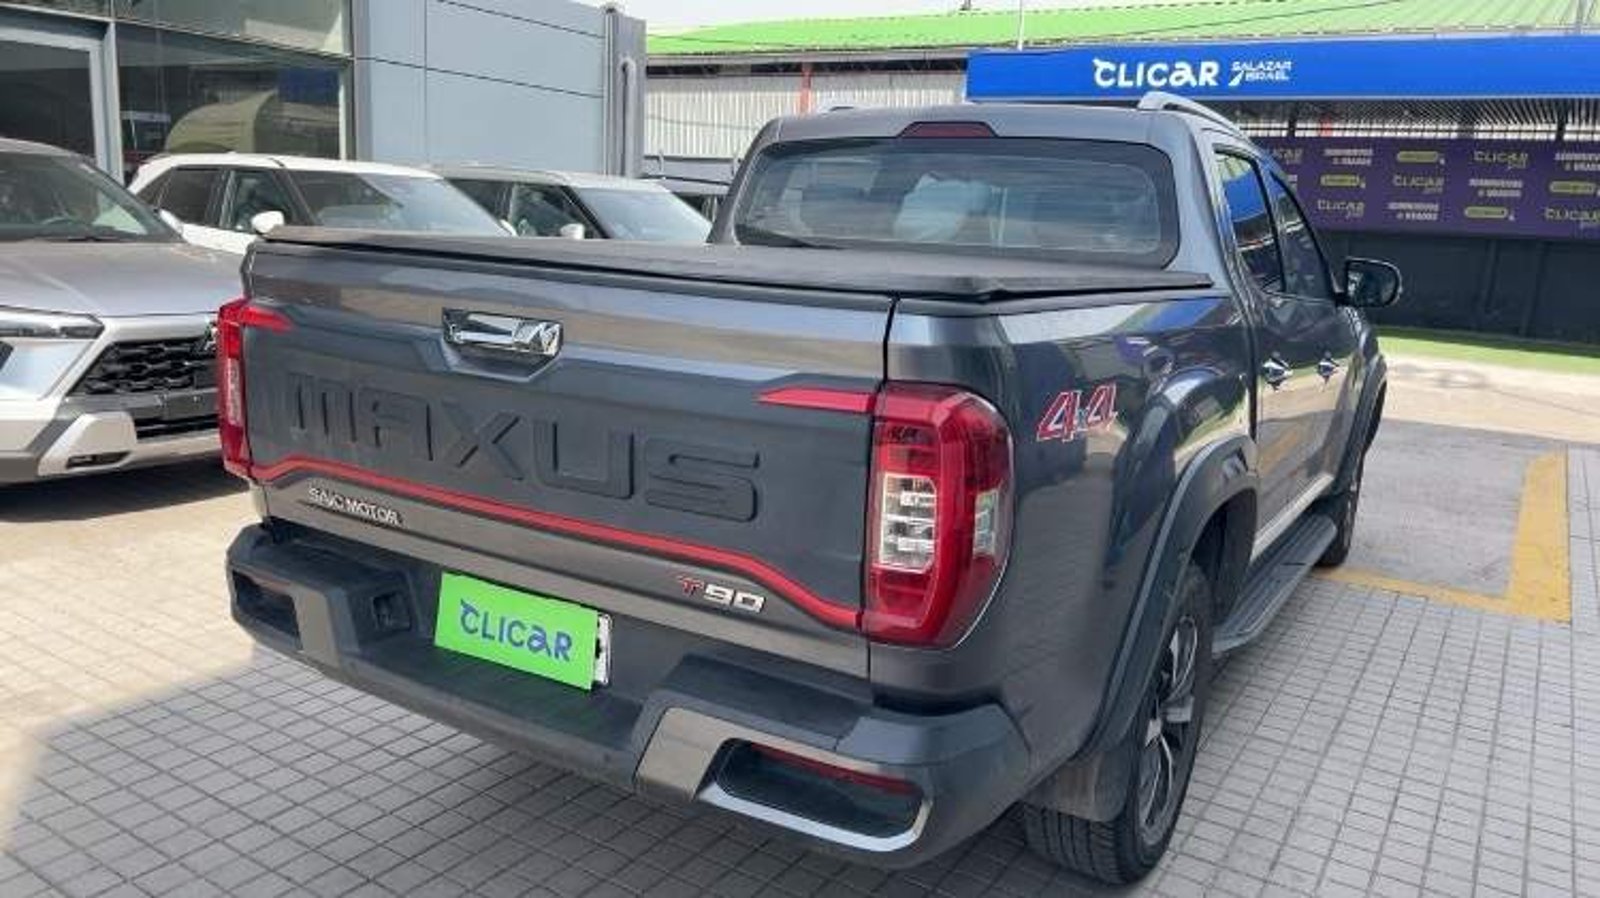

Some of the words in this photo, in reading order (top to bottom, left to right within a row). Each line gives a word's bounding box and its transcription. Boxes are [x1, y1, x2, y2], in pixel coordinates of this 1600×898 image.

[1231, 61, 1292, 71] SALAZAR
[286, 373, 760, 523] MAXUS
[345, 498, 401, 525] MOTOR
